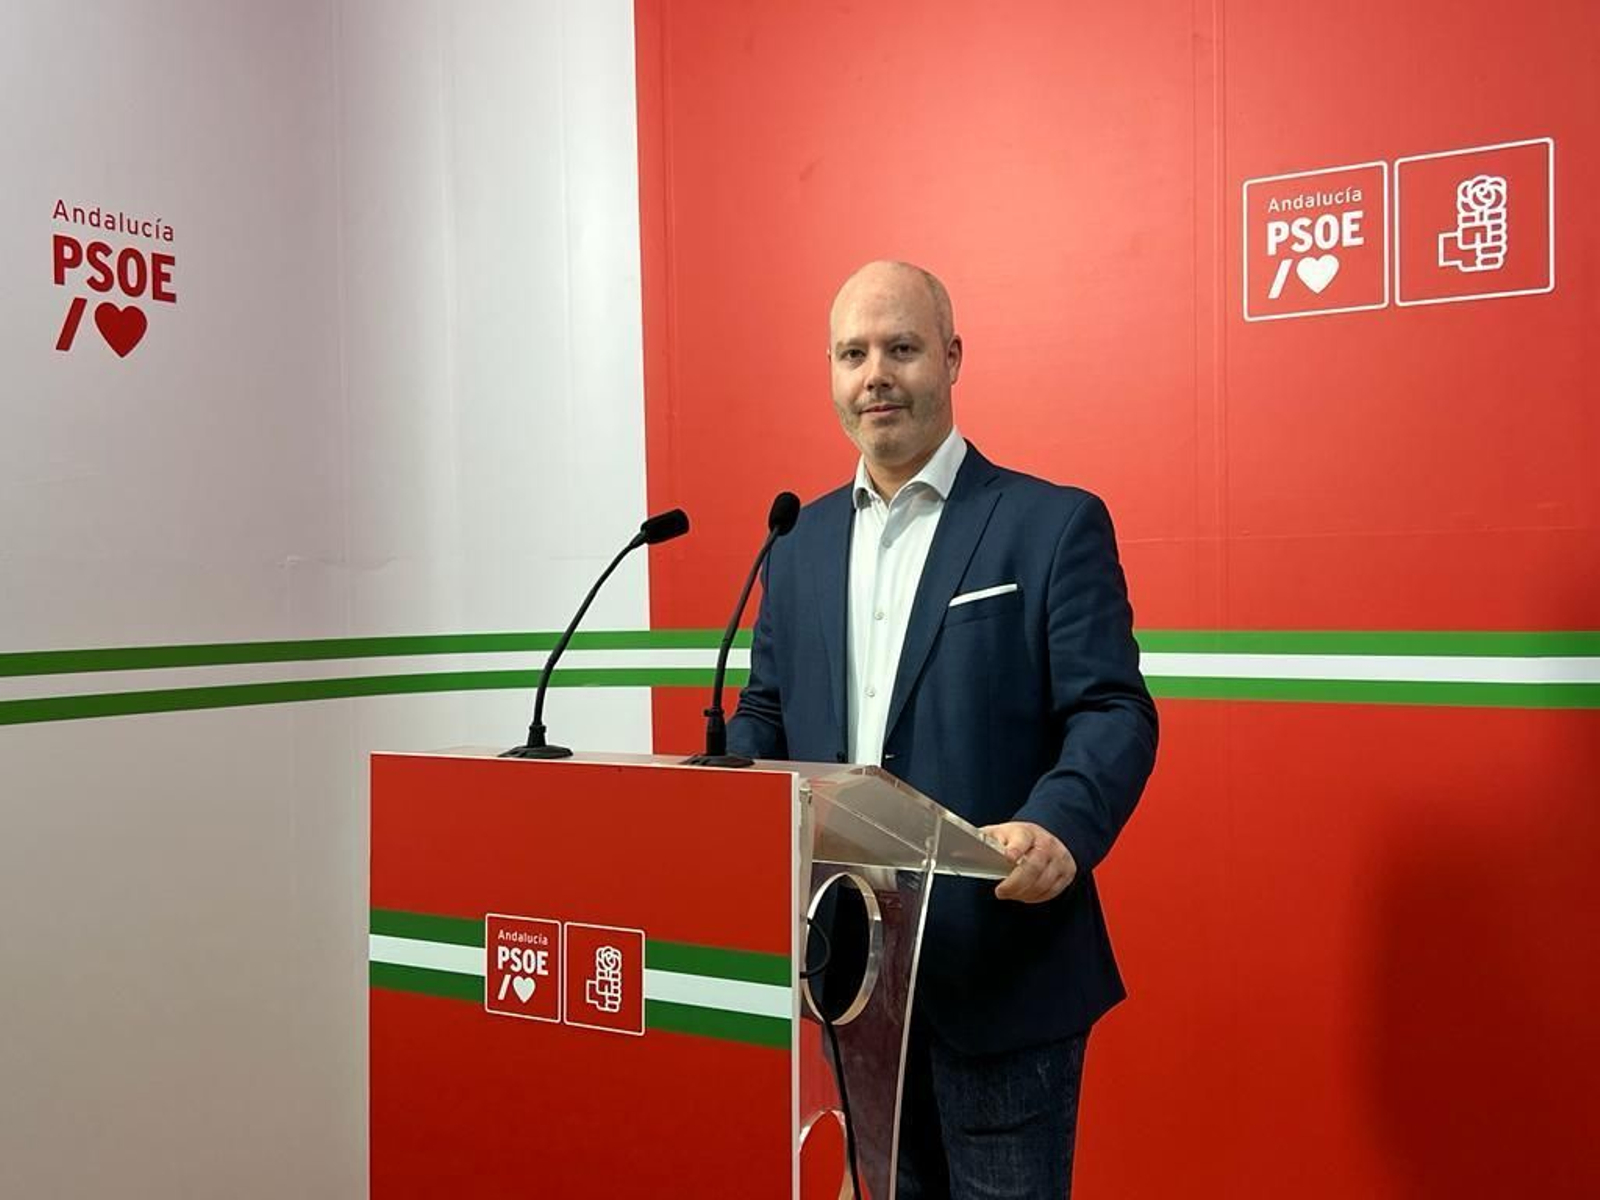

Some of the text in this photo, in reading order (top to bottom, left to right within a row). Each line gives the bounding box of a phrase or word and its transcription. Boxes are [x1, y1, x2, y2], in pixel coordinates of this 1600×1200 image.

[53, 199, 174, 242] Andalucía
[1267, 186, 1363, 213] Andalucía
[1266, 210, 1364, 256] PSOE
[53, 234, 177, 304] PSOE
[497, 946, 549, 976] PSOE
